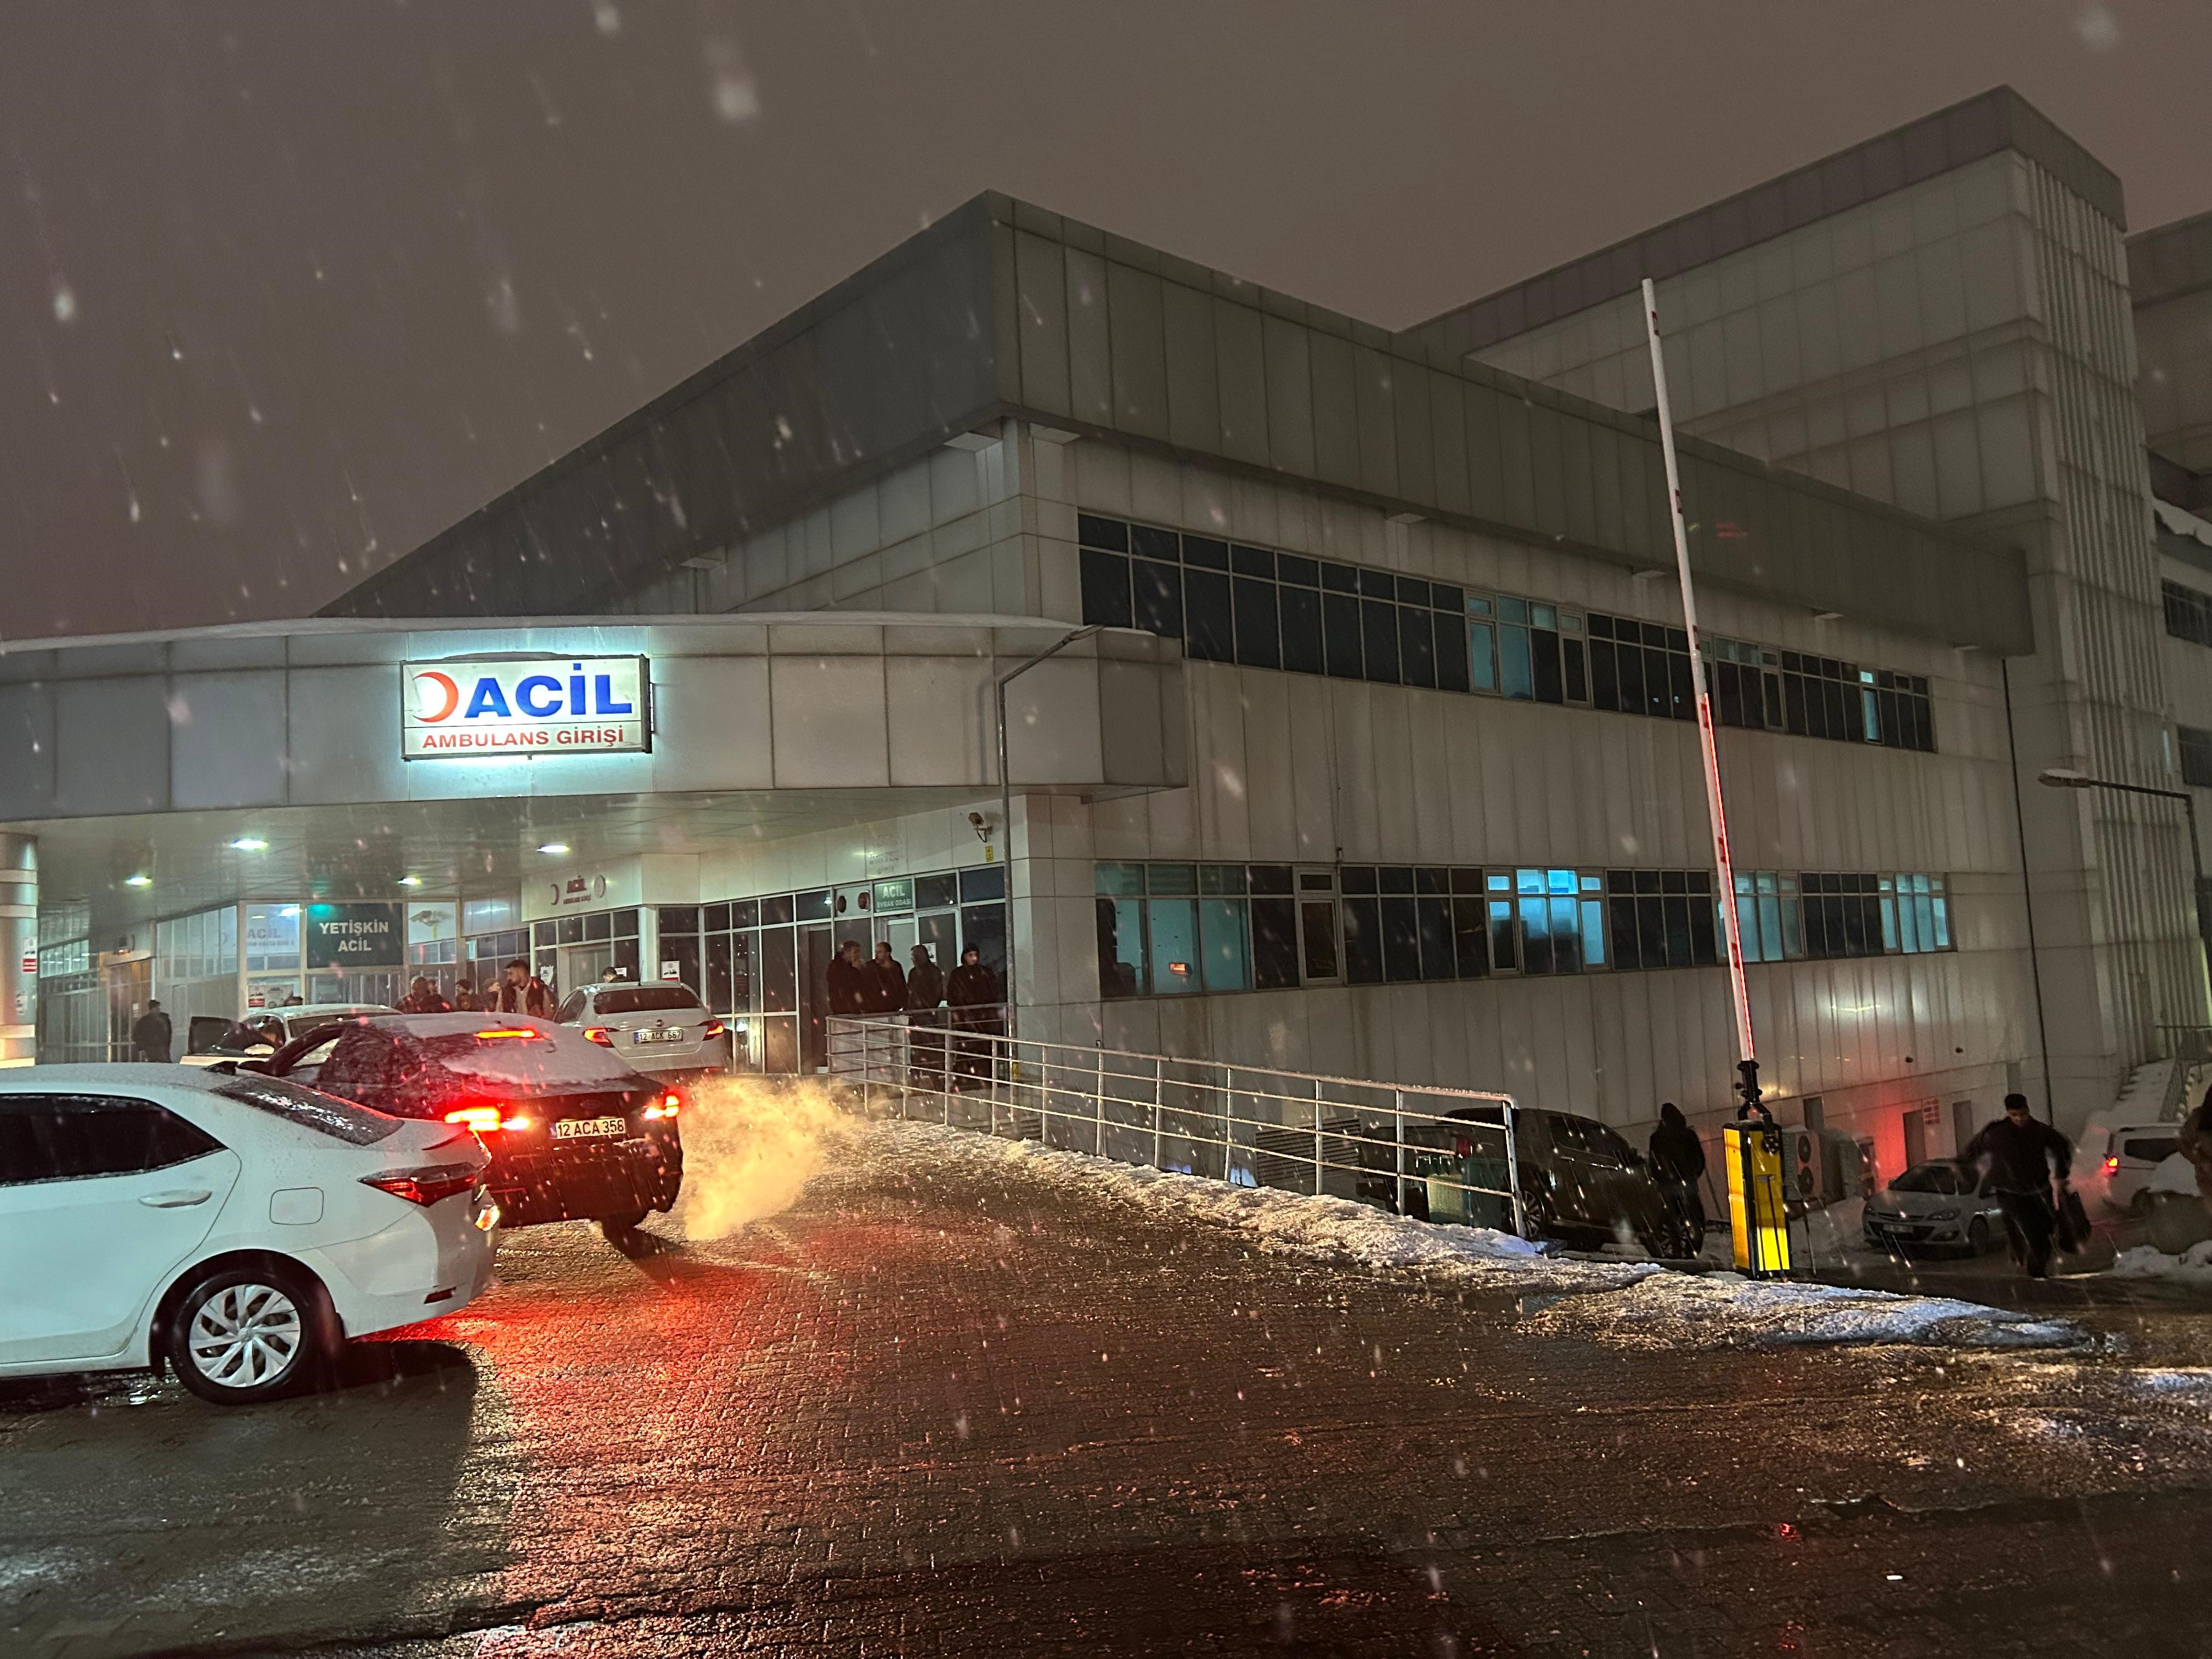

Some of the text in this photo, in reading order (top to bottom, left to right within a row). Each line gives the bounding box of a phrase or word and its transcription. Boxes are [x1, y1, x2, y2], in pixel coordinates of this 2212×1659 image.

[464, 663, 633, 719] ACİL
[422, 725, 624, 748] AMBULANS GİRİŞİ
[319, 918, 389, 937] YETİŞKİN
[337, 937, 372, 952] ACİL
[668, 1031, 681, 1039] 667
[558, 1119, 624, 1137] 12 ACA 358
